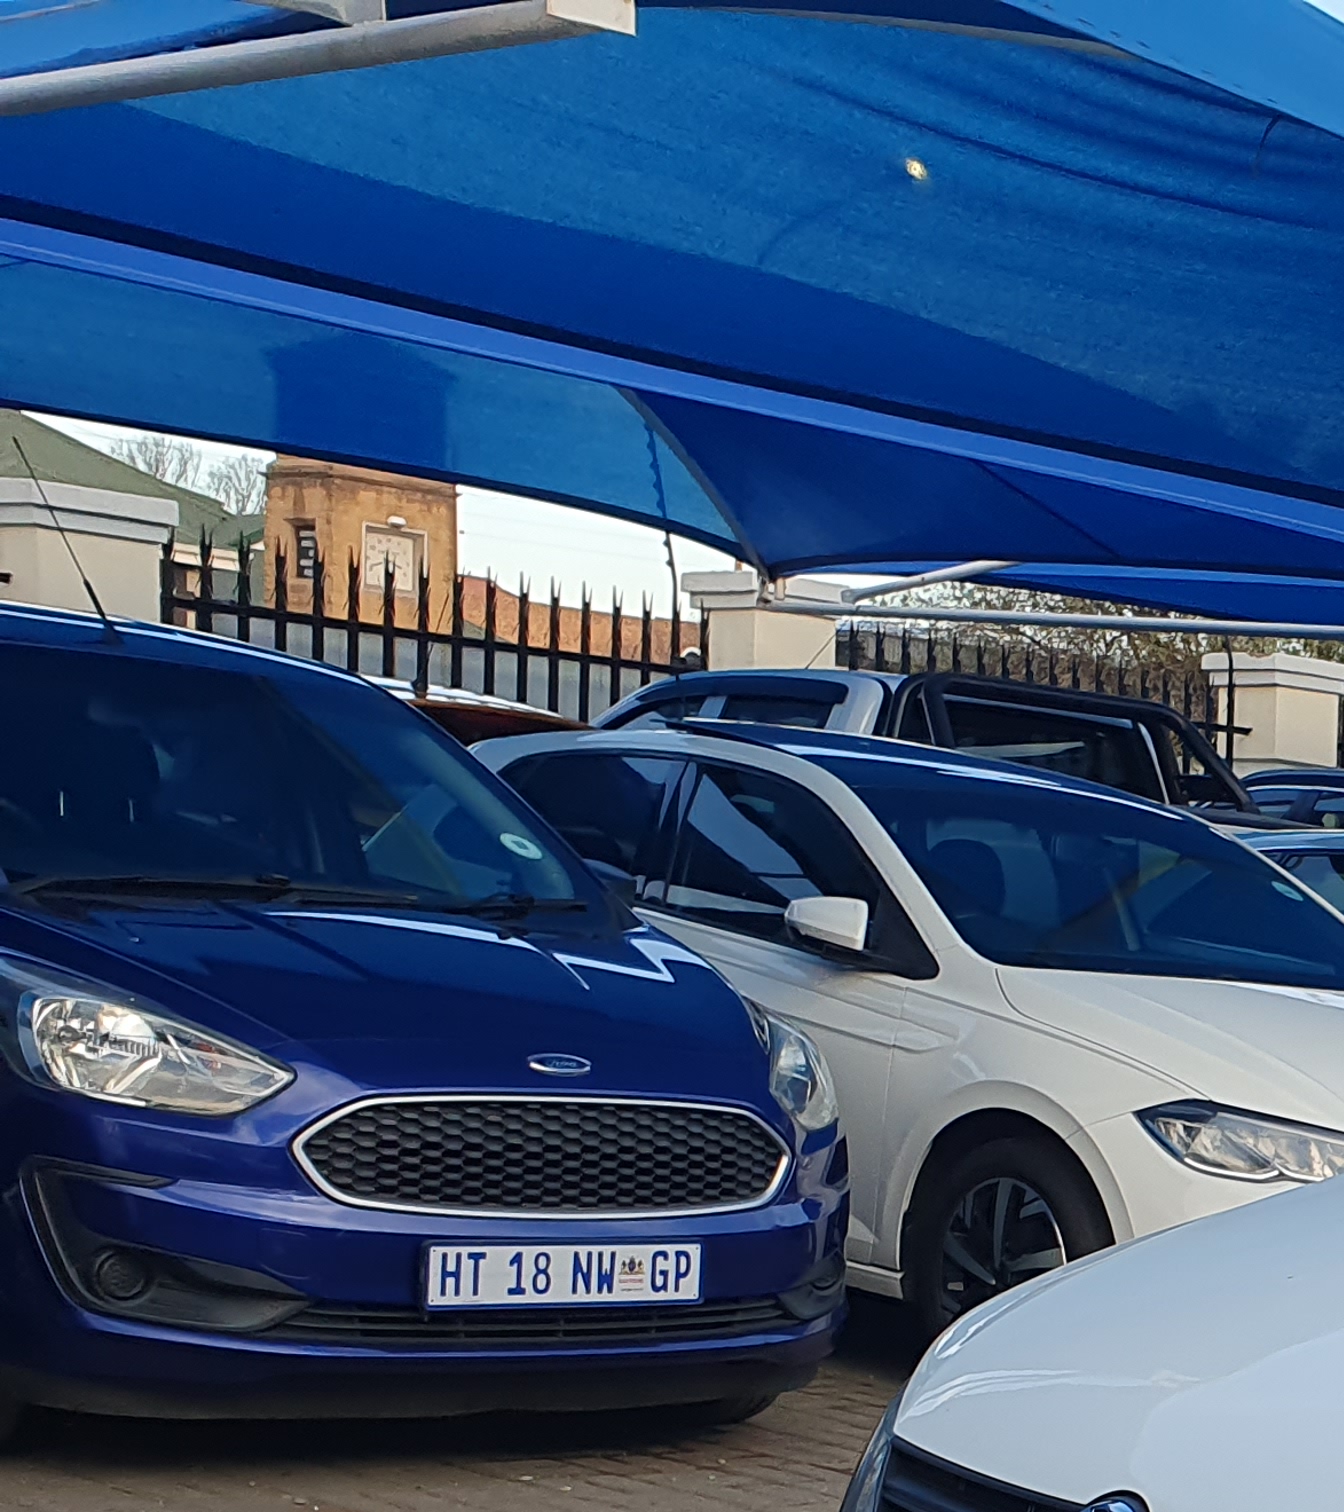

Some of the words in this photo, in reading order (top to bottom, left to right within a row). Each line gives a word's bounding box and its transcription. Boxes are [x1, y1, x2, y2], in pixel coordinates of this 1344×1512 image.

[440, 1252, 487, 1297] HT
[507, 1252, 551, 1295] 18
[571, 1250, 617, 1295] NW
[651, 1250, 692, 1293] GP
